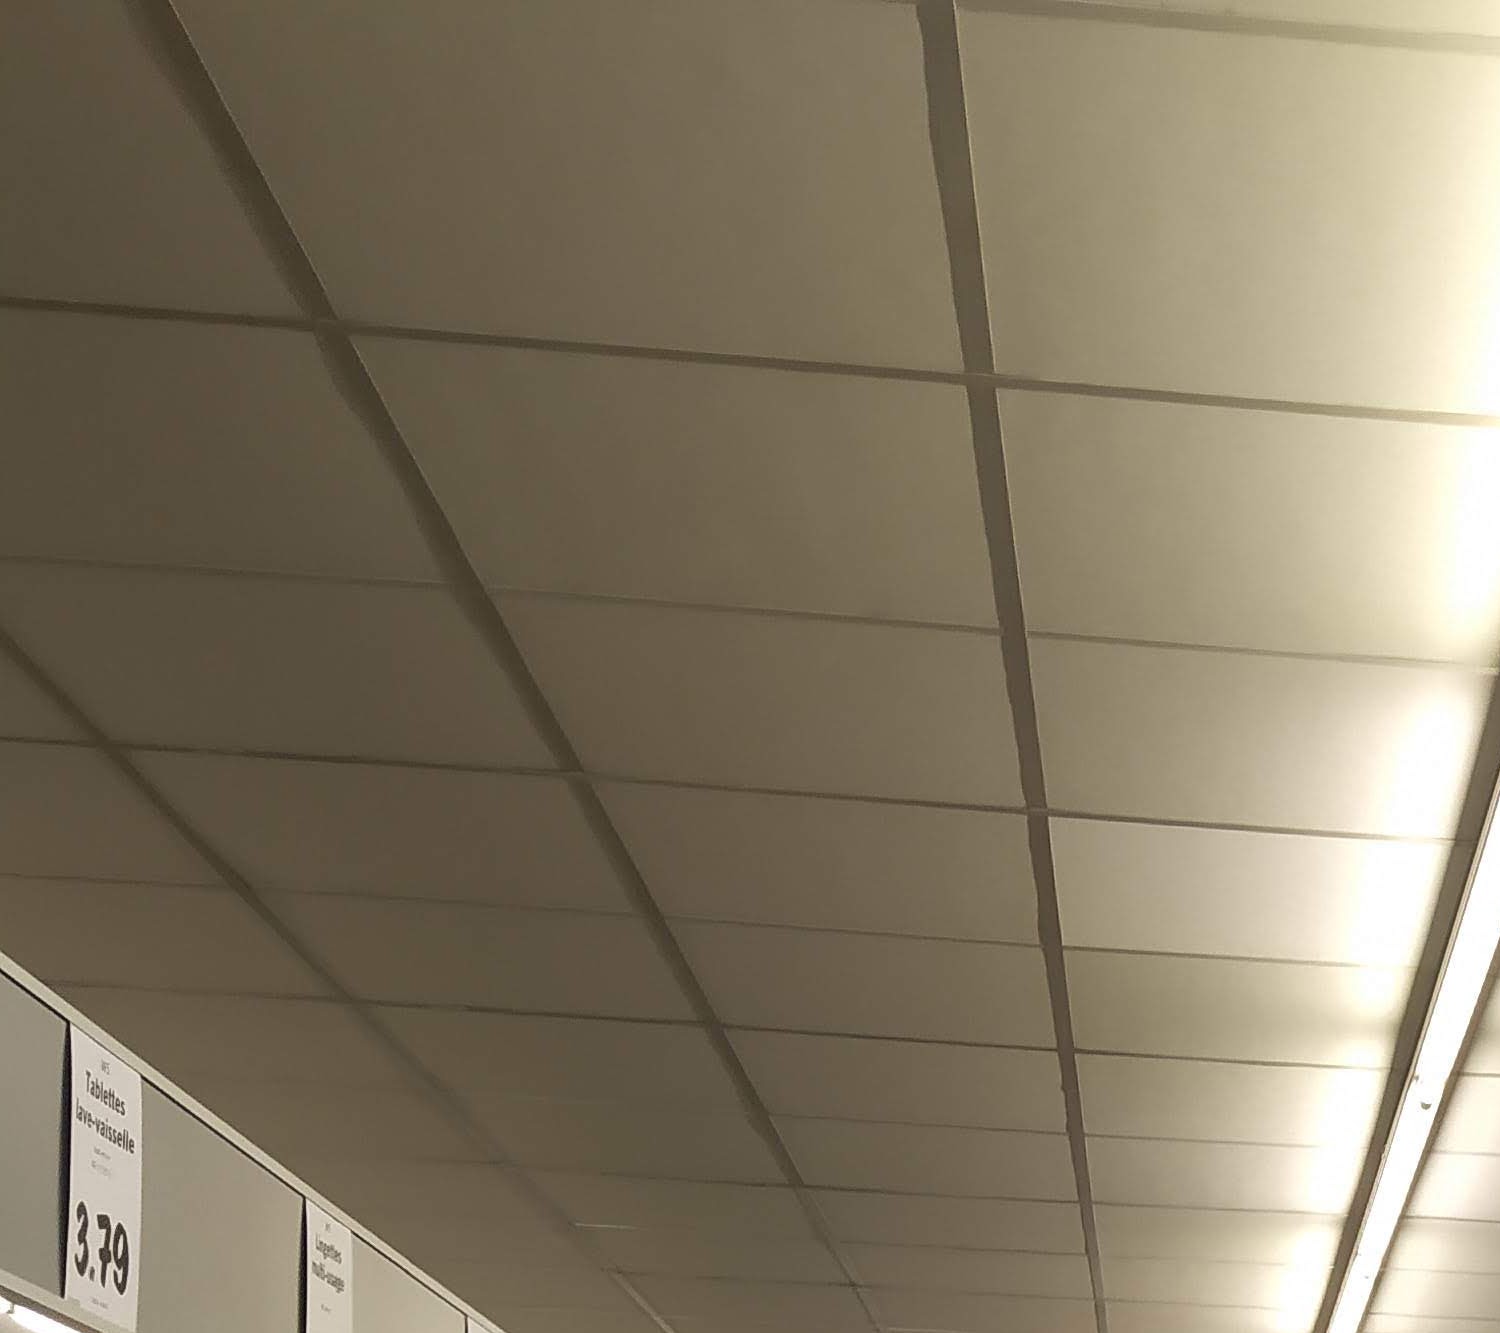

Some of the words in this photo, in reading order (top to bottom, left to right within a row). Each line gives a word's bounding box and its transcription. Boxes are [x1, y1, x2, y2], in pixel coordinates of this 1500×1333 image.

[85, 1070, 126, 1117] Tablettes
[76, 1098, 135, 1155] lave-vaisselle
[74, 1201, 129, 1296] 3.79
